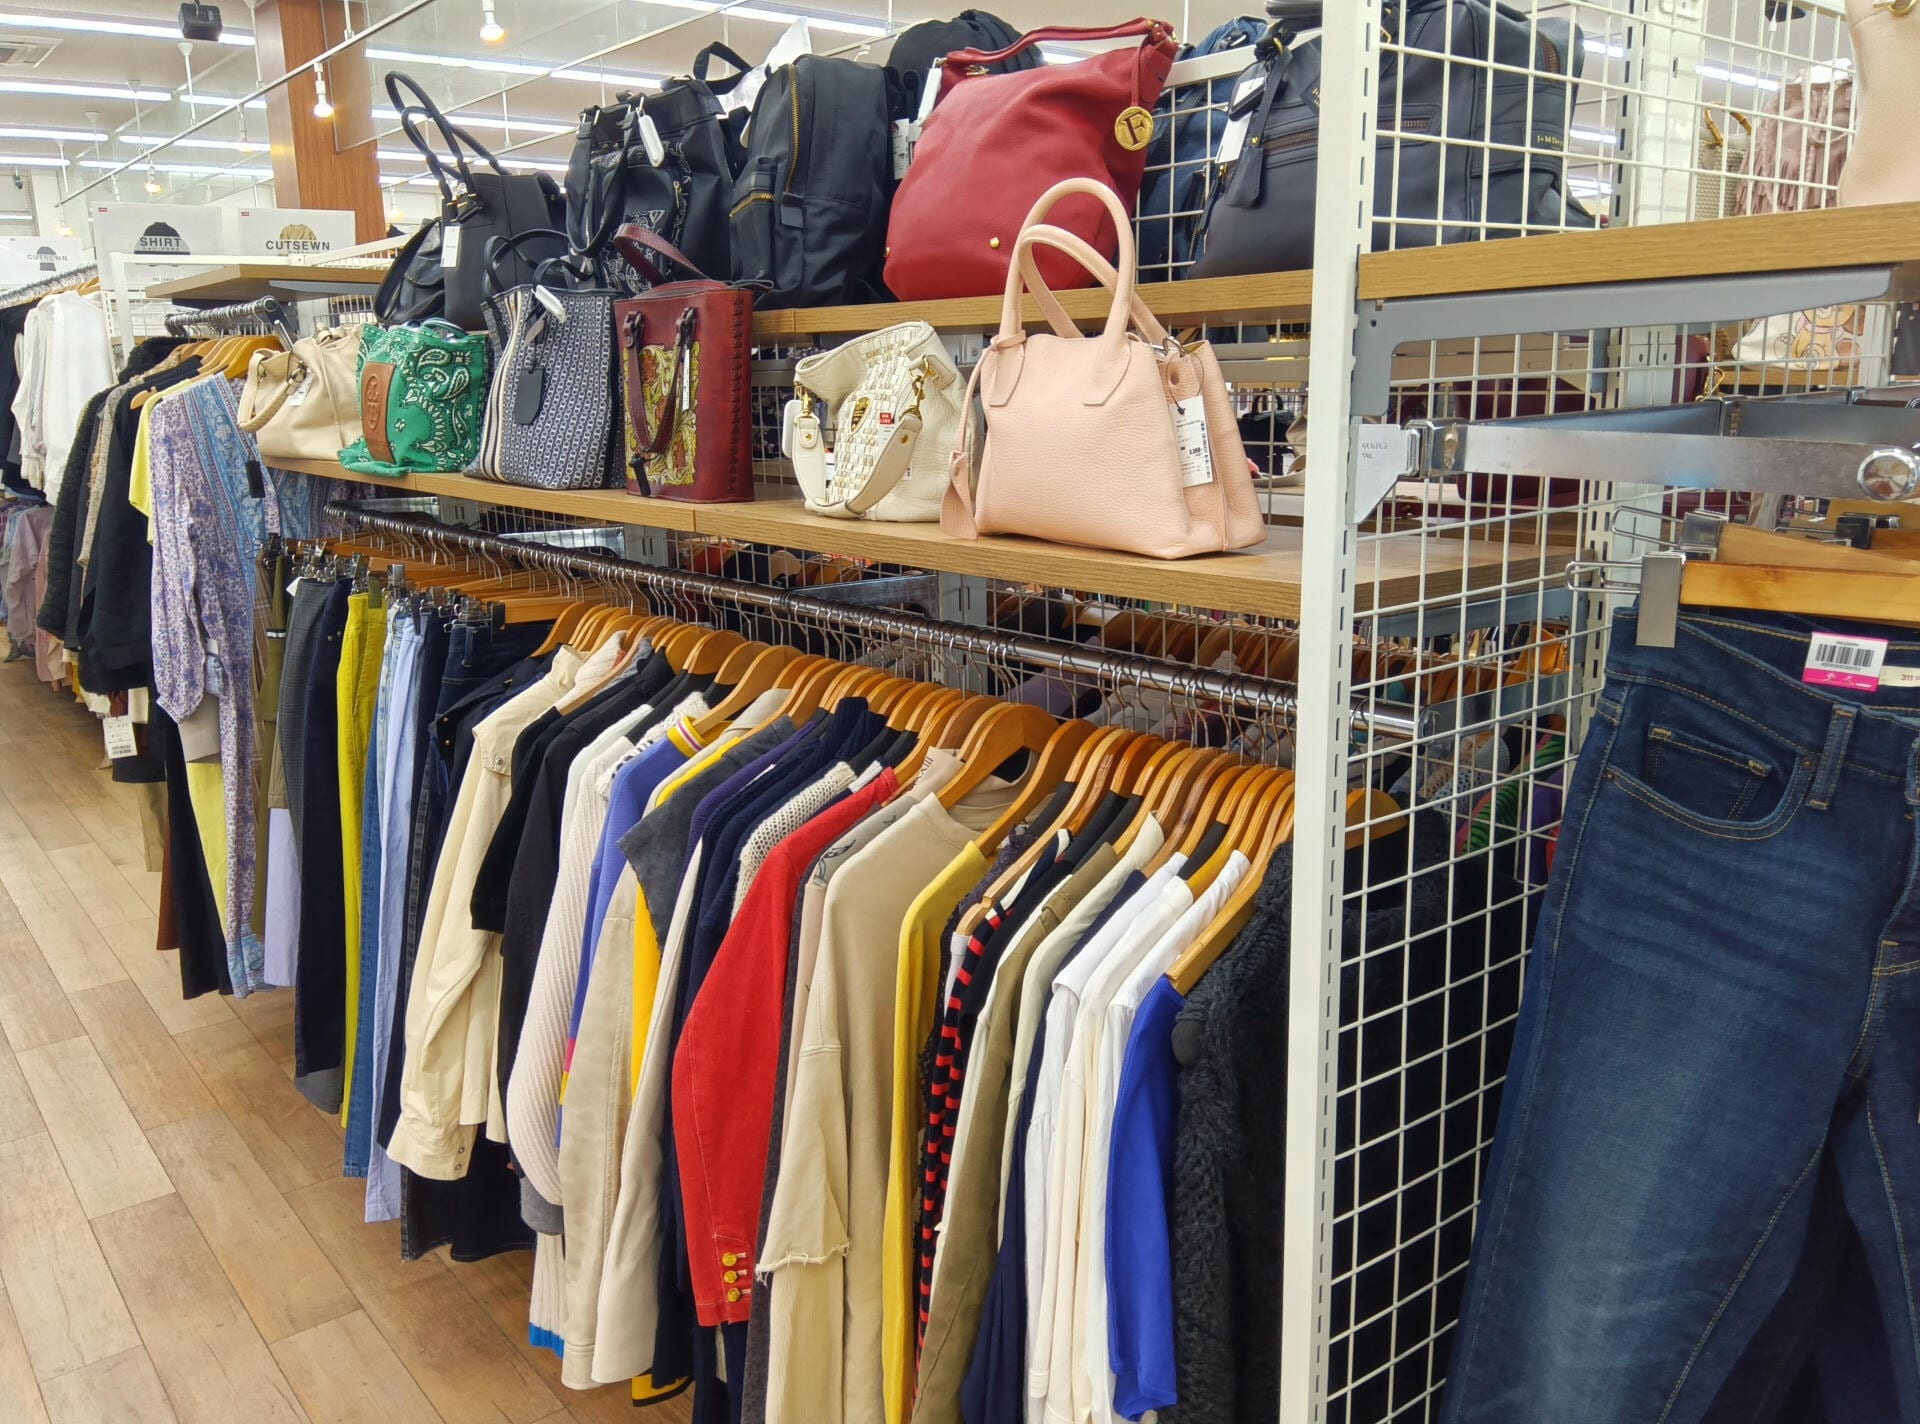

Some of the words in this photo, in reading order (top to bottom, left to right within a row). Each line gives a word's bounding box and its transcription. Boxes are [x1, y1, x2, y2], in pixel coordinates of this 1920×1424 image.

[1121, 110, 1146, 146] F
[139, 237, 182, 247] SHIRT
[265, 240, 330, 250] CUTSEWN
